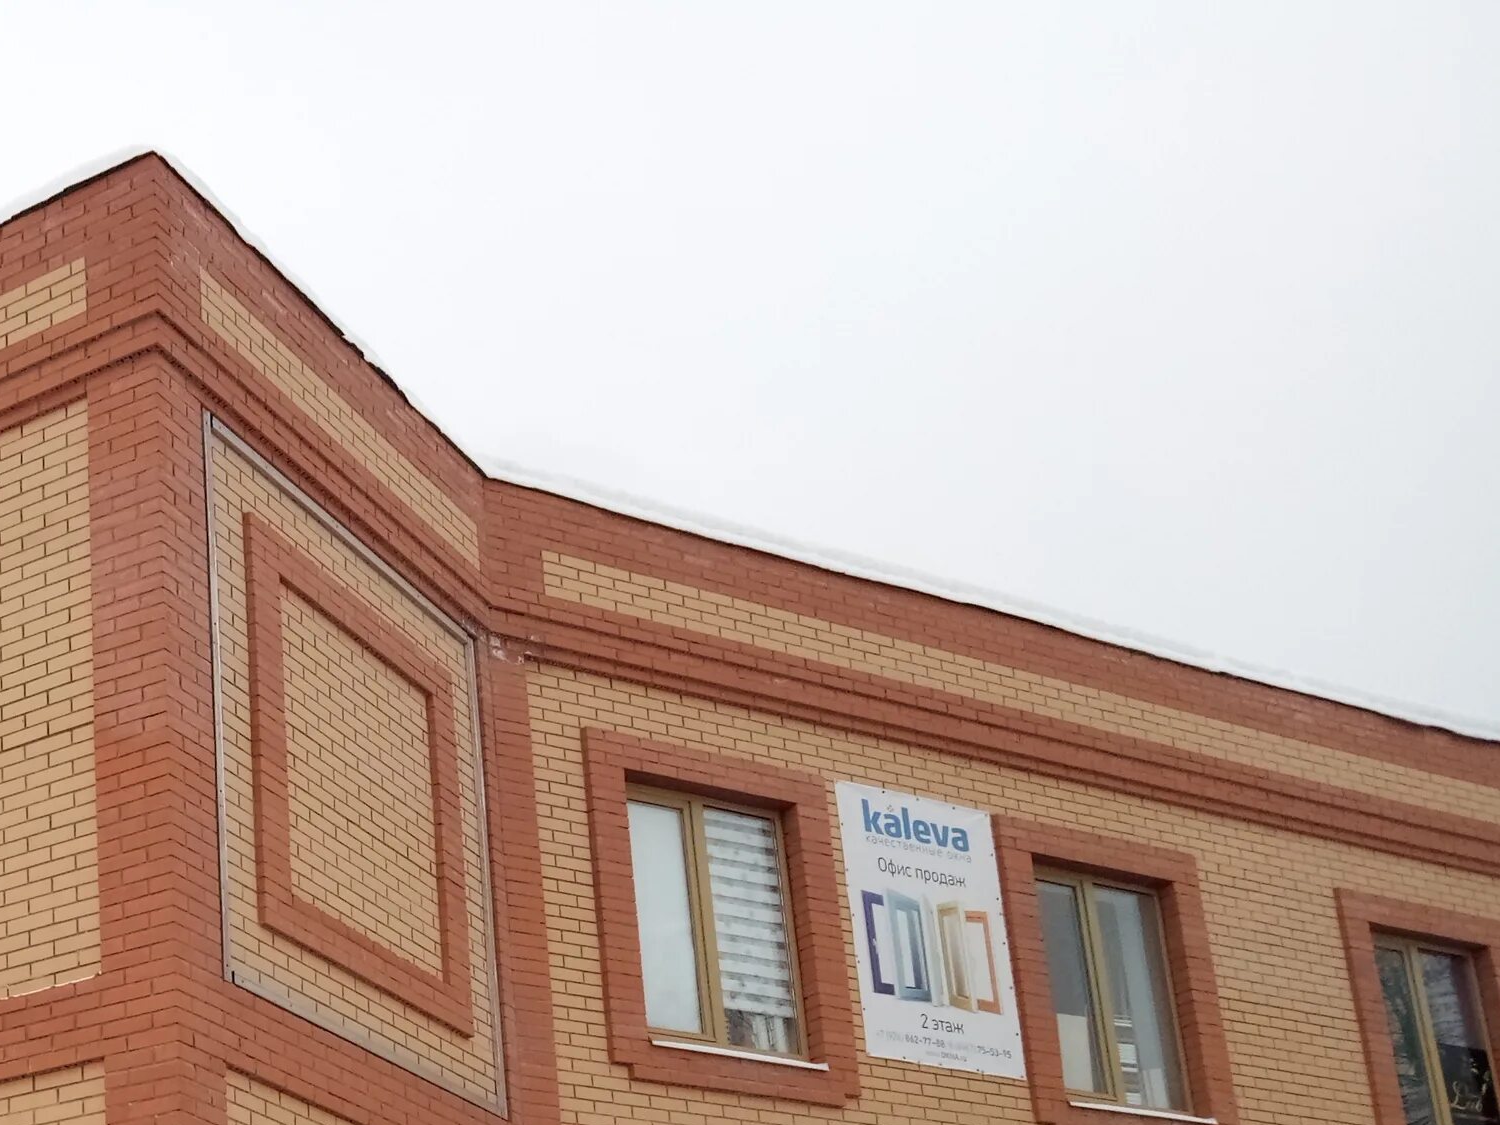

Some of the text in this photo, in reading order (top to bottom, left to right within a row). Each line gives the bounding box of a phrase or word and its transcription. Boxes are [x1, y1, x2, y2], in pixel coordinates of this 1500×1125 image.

[861, 798, 969, 852] kaleva
[878, 857, 966, 888] Офис продаж
[920, 1013, 964, 1034] 2 этаж
